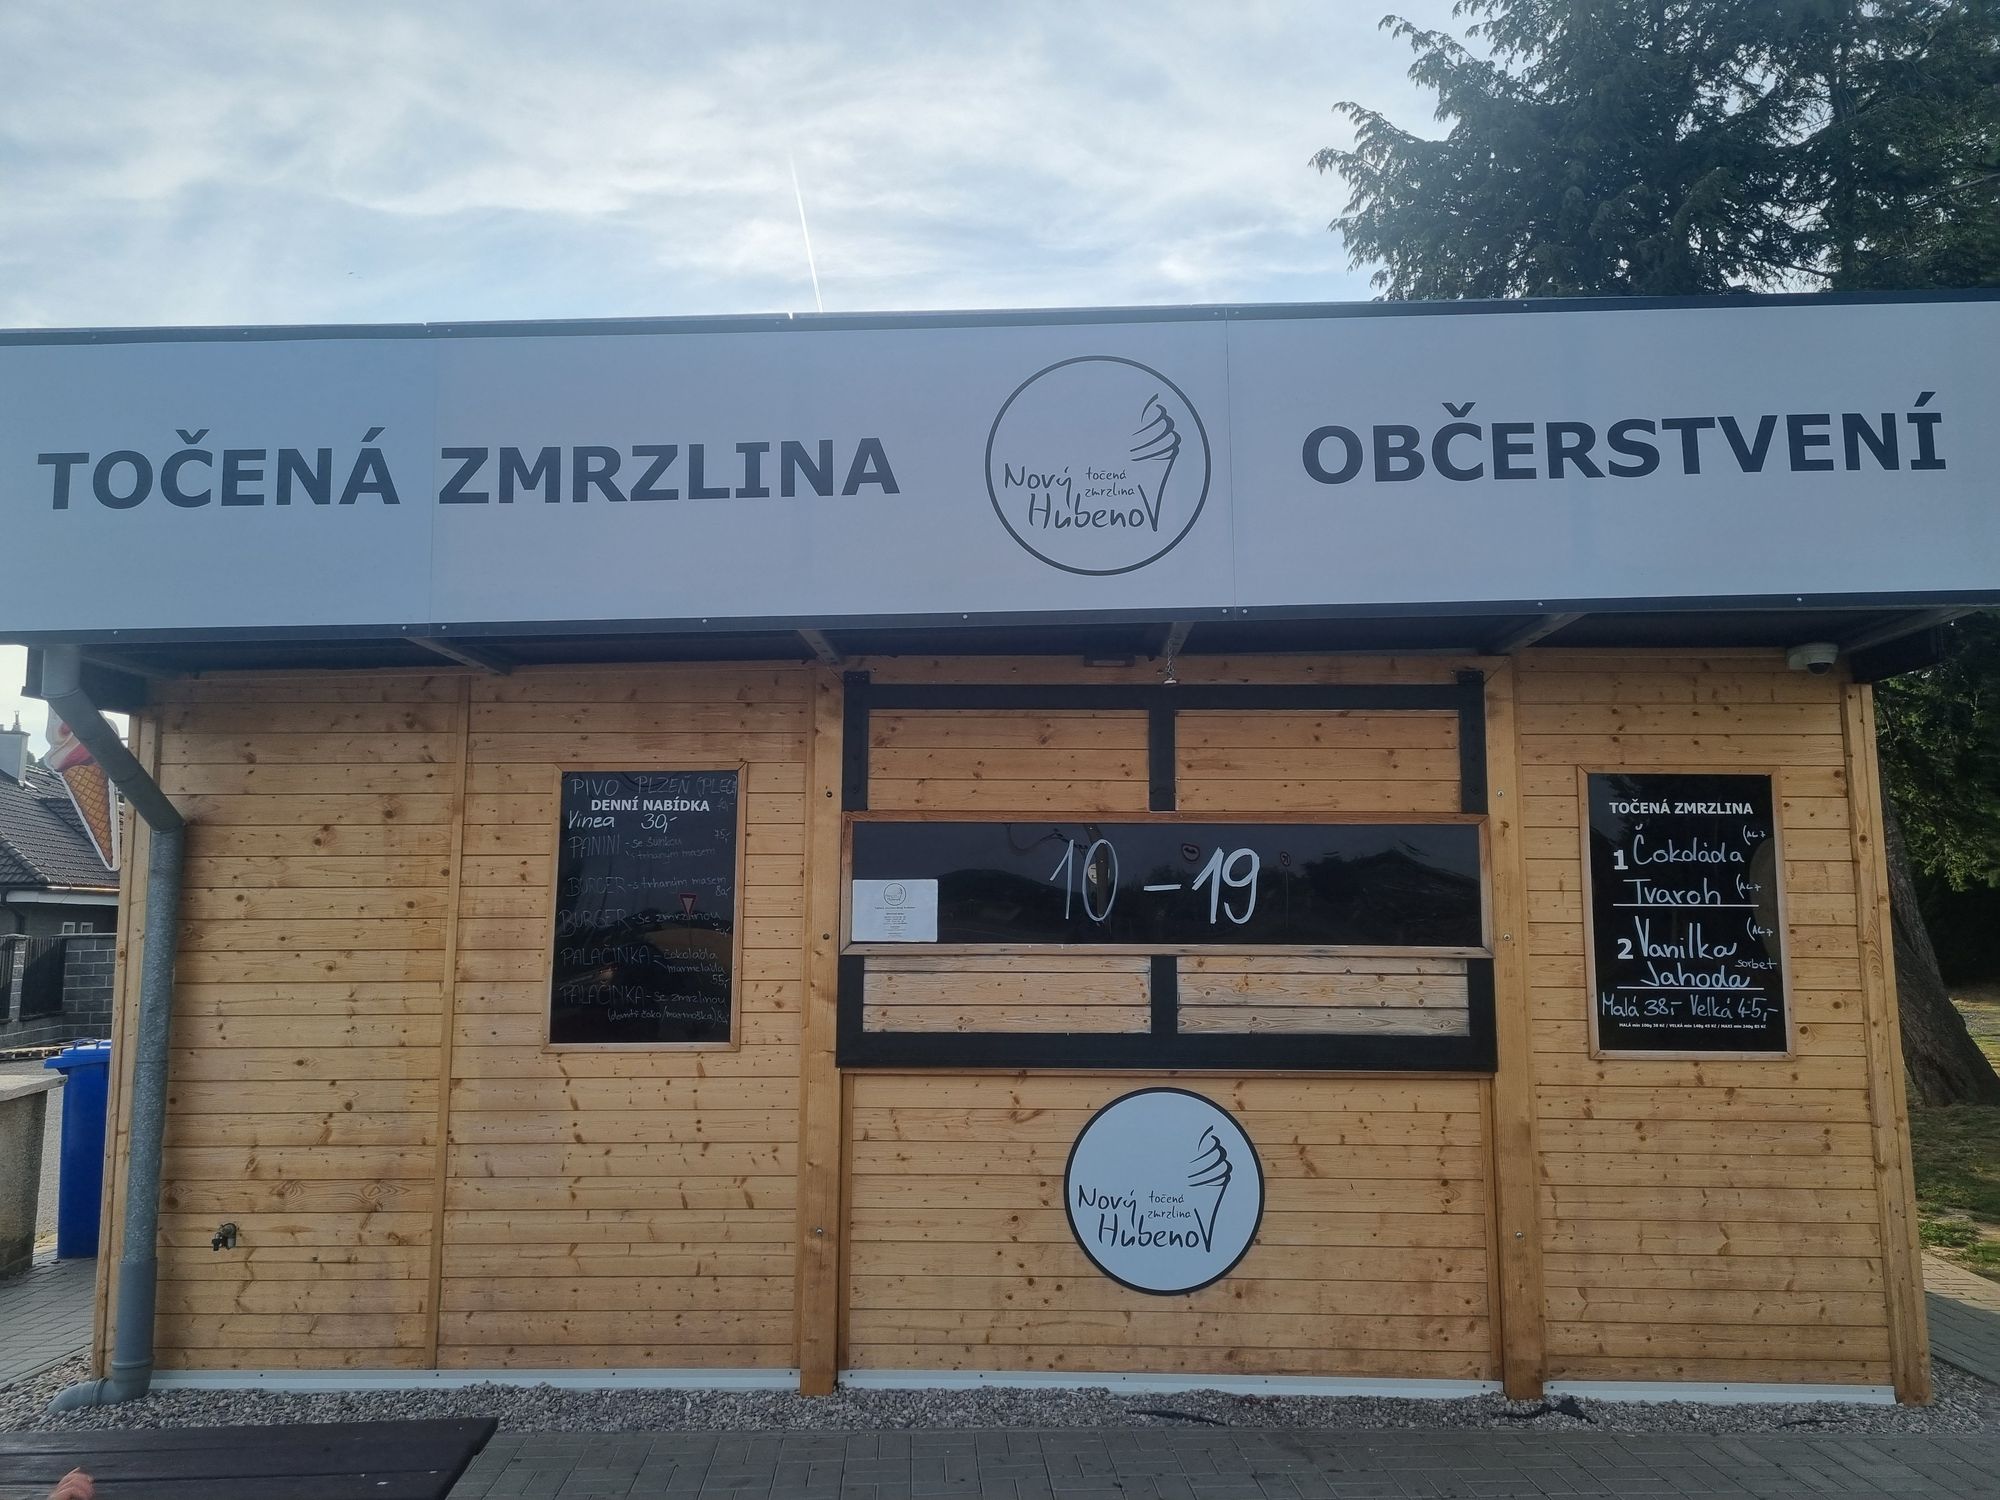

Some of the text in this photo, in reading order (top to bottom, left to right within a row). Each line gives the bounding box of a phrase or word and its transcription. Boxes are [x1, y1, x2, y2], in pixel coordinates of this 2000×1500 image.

[1302, 392, 1946, 484] OBČERSTVENÍ
[37, 427, 900, 509] TOČENÁ ZMRZLINA
[1004, 463, 1127, 509] Nový točená
[1085, 482, 1136, 498] zmrzlina
[571, 777, 620, 797] PIVO
[635, 774, 692, 794] PLZEŇ
[591, 796, 639, 811] DENNÍ
[643, 796, 710, 812] NABÍDKA
[1609, 798, 1754, 815] TOČENÁ ZMRZLINA
[568, 809, 616, 830] Vinea
[568, 833, 621, 858] PANINI
[1633, 823, 1745, 866] Čokoláda
[1613, 849, 1629, 870] 1
[1050, 839, 1119, 922] 10
[1192, 846, 1260, 925] 19
[1622, 877, 1722, 905] Tvaroh
[559, 909, 632, 937] BURGER
[1617, 938, 1634, 960] 2
[1634, 915, 1738, 960] Vanilka
[560, 944, 650, 967] PALAČINKA
[1734, 959, 1778, 970] sorbet
[1640, 961, 1751, 988] Jahoda
[559, 977, 644, 1007] PALAČINKA
[1602, 991, 1640, 1017] Malá
[1690, 993, 1733, 1020] Velká
[1078, 1184, 1185, 1229] Nový točená
[1147, 1206, 1191, 1220] zmrzlina
